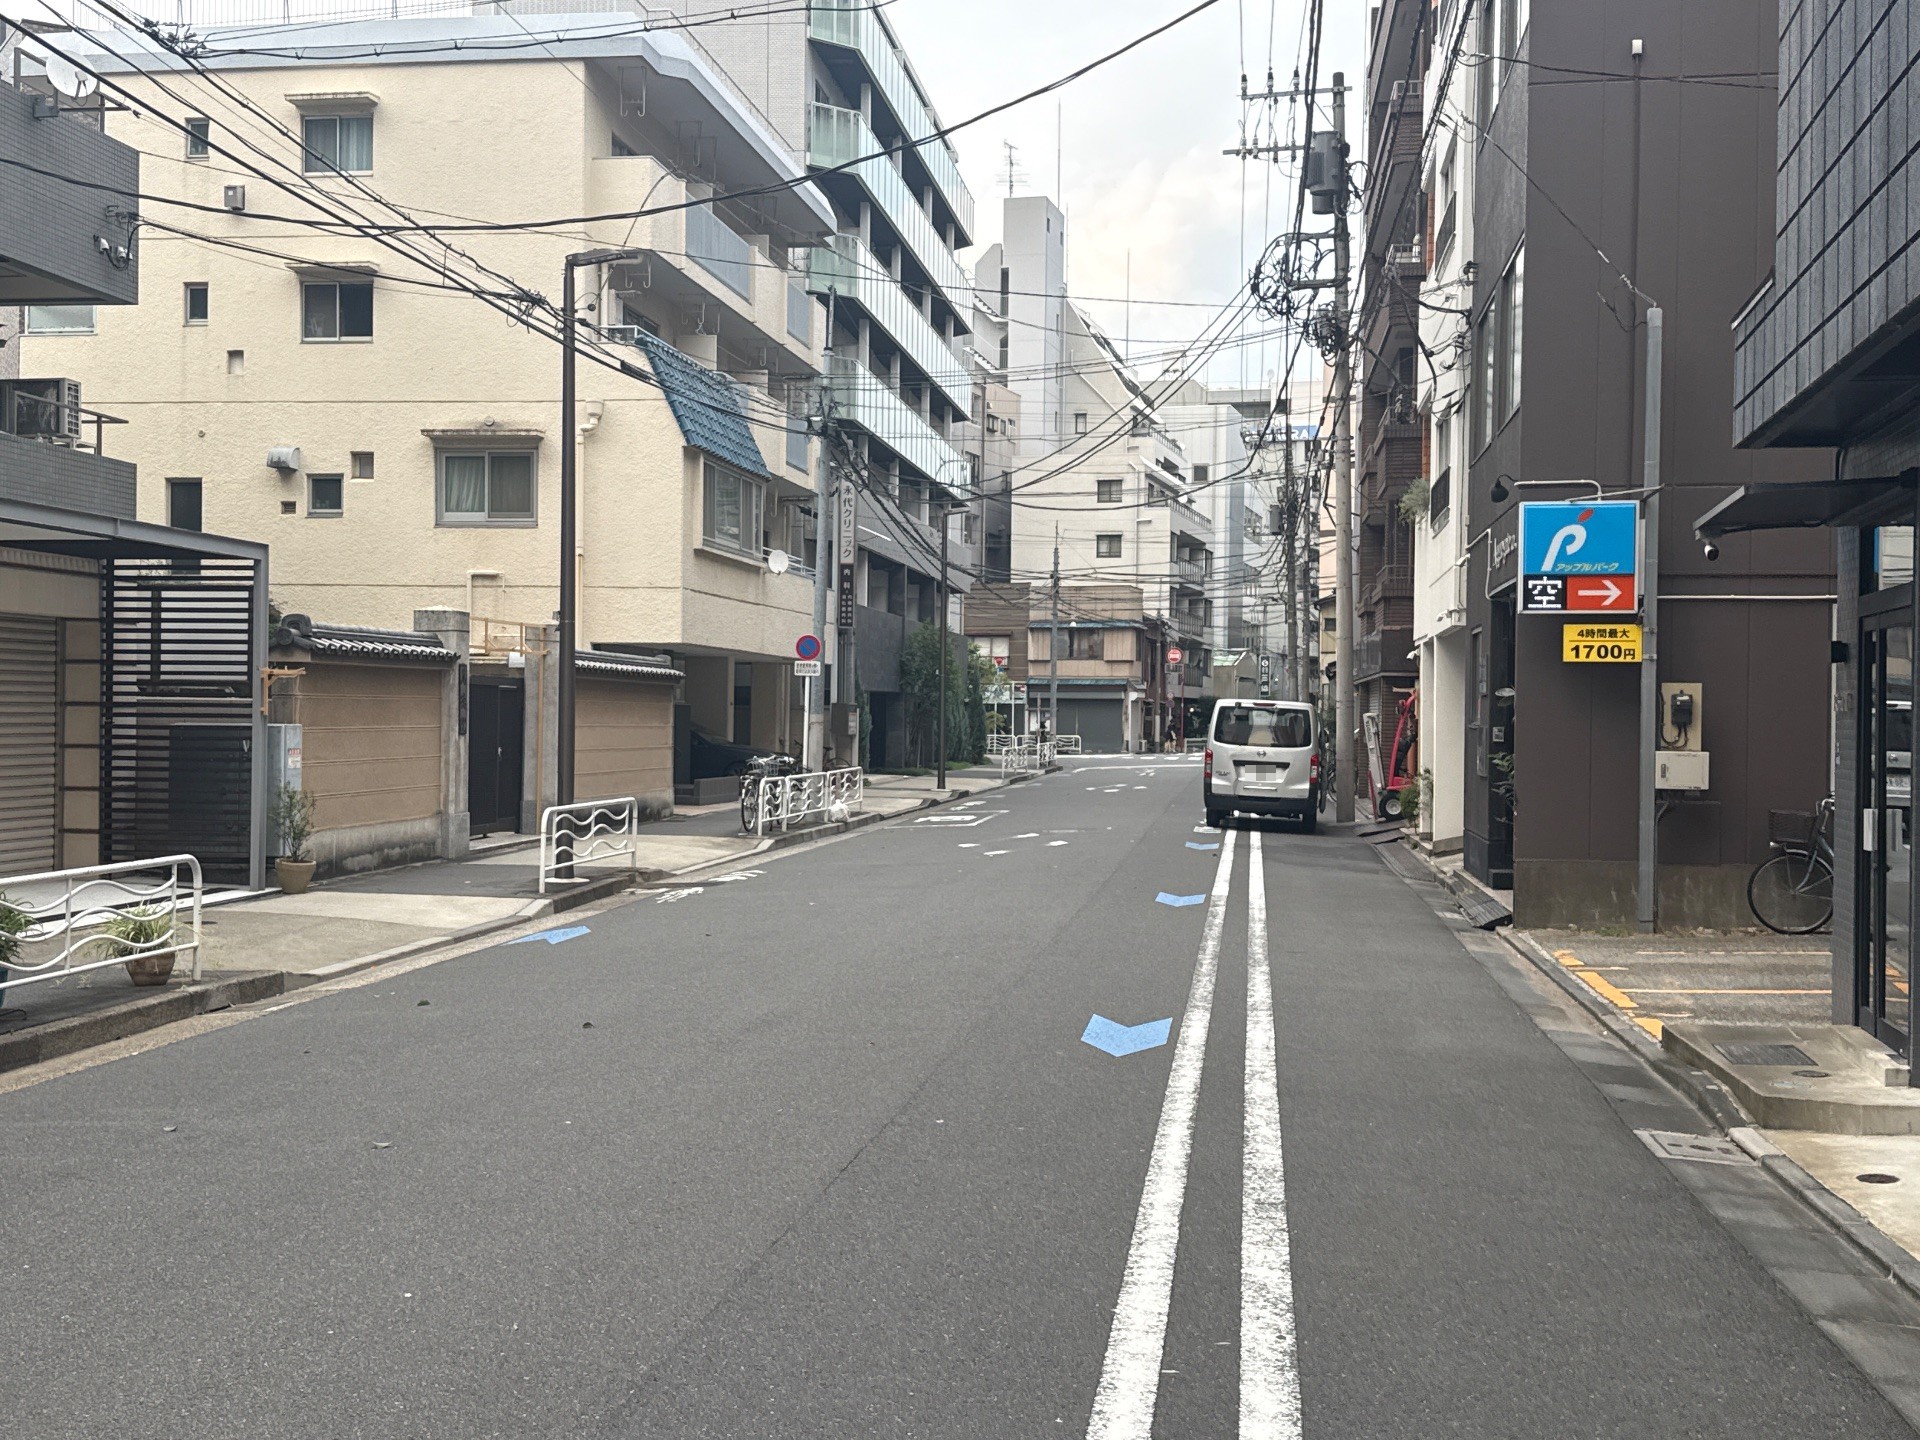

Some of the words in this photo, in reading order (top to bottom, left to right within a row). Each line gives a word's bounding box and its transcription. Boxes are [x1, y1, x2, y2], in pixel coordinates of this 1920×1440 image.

[1555, 563, 1619, 572] アップルパーク
[1527, 576, 1563, 609] 空
[1577, 628, 1630, 639] 4時間最大
[1570, 644, 1636, 661] 1700円
